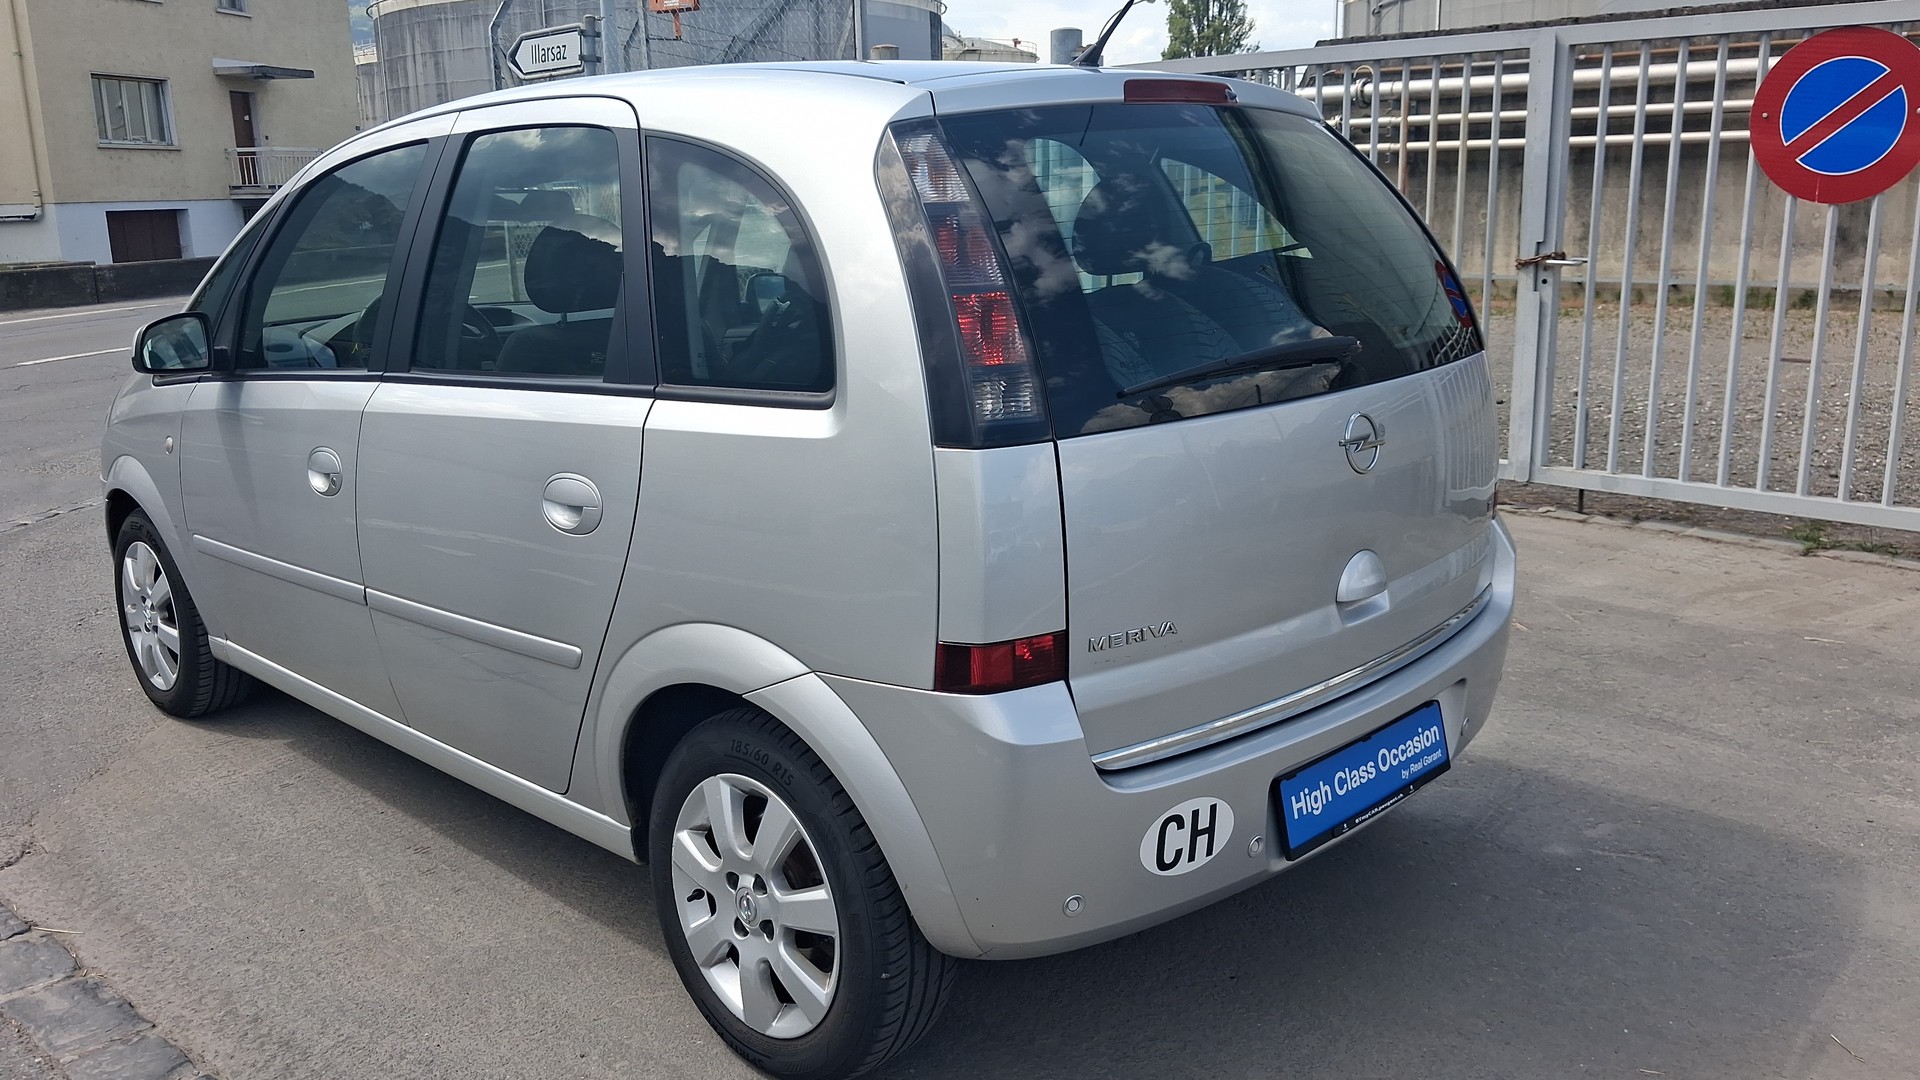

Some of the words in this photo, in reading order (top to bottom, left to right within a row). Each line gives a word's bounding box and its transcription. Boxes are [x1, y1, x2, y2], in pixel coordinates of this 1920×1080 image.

[530, 43, 567, 65] Illarsaz
[1087, 620, 1178, 653] MERIVA
[730, 739, 770, 766] 185/60
[771, 761, 794, 786] R15
[1290, 780, 1333, 820] High
[1334, 760, 1376, 796] Class
[1377, 724, 1440, 772] Occasion
[1401, 768, 1410, 780] by
[1410, 758, 1424, 774] Real
[1423, 748, 1442, 766] Garant
[1155, 802, 1218, 873] CH
